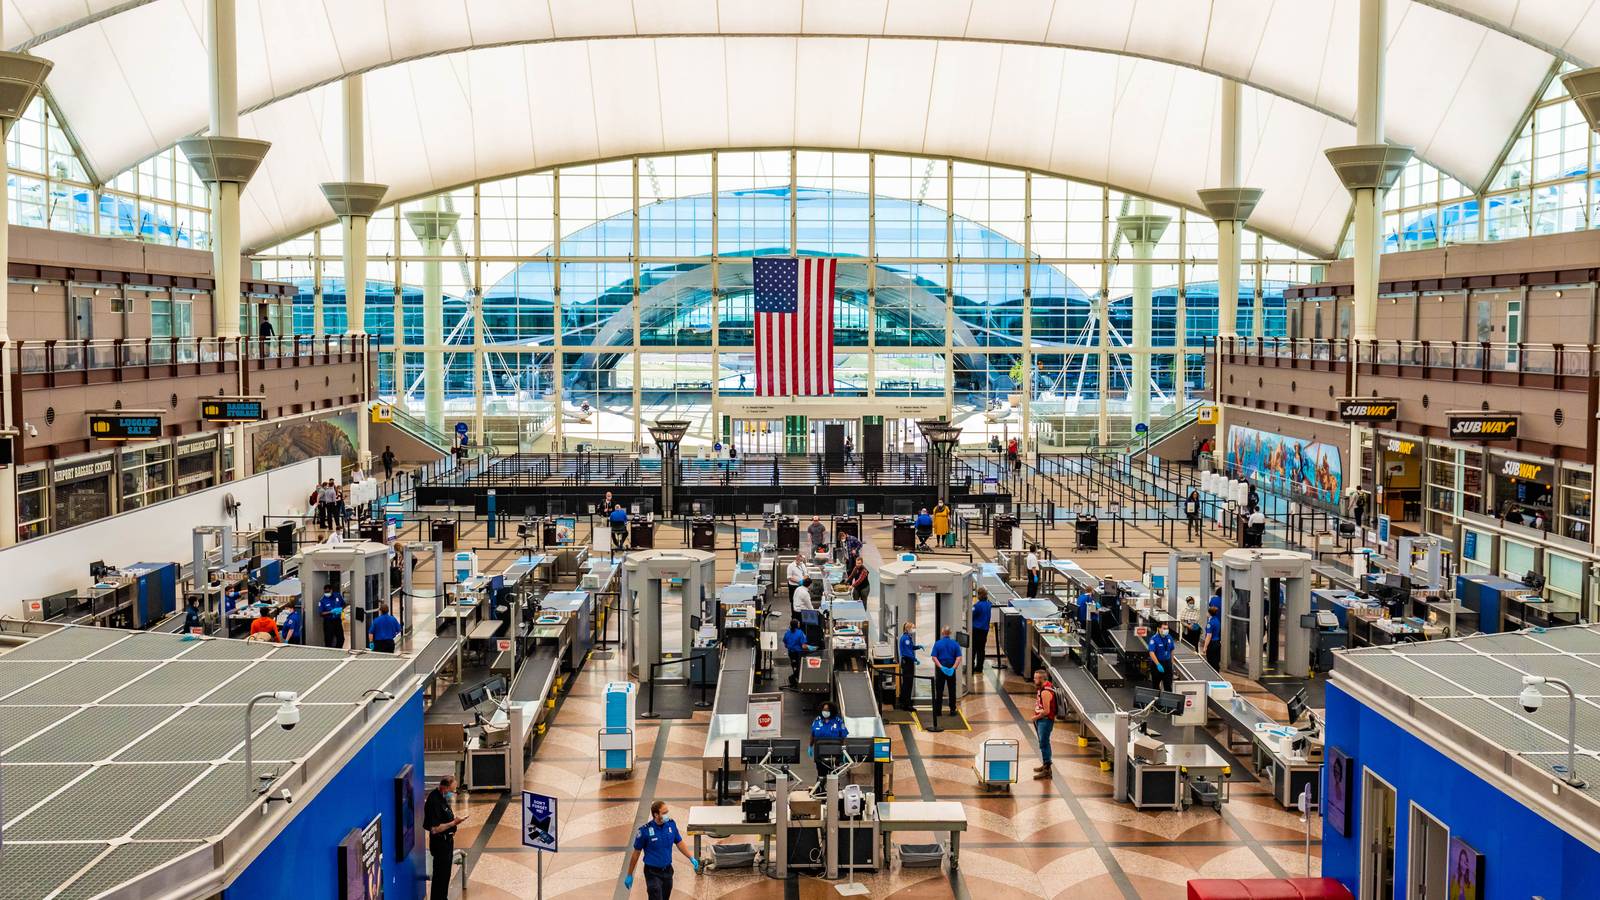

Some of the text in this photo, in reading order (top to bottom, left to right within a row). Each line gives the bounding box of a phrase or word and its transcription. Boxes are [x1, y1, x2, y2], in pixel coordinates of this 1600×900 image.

[1343, 405, 1395, 416] SUBWAY
[120, 419, 158, 427] LUGGAGE
[1452, 421, 1516, 433] SUBWAY
[127, 427, 151, 435] SALE
[1387, 439, 1414, 454] SUBWAY
[54, 460, 112, 482] AIRPORT BAGGAGE CENTER
[1502, 460, 1542, 479] SUBWAY
